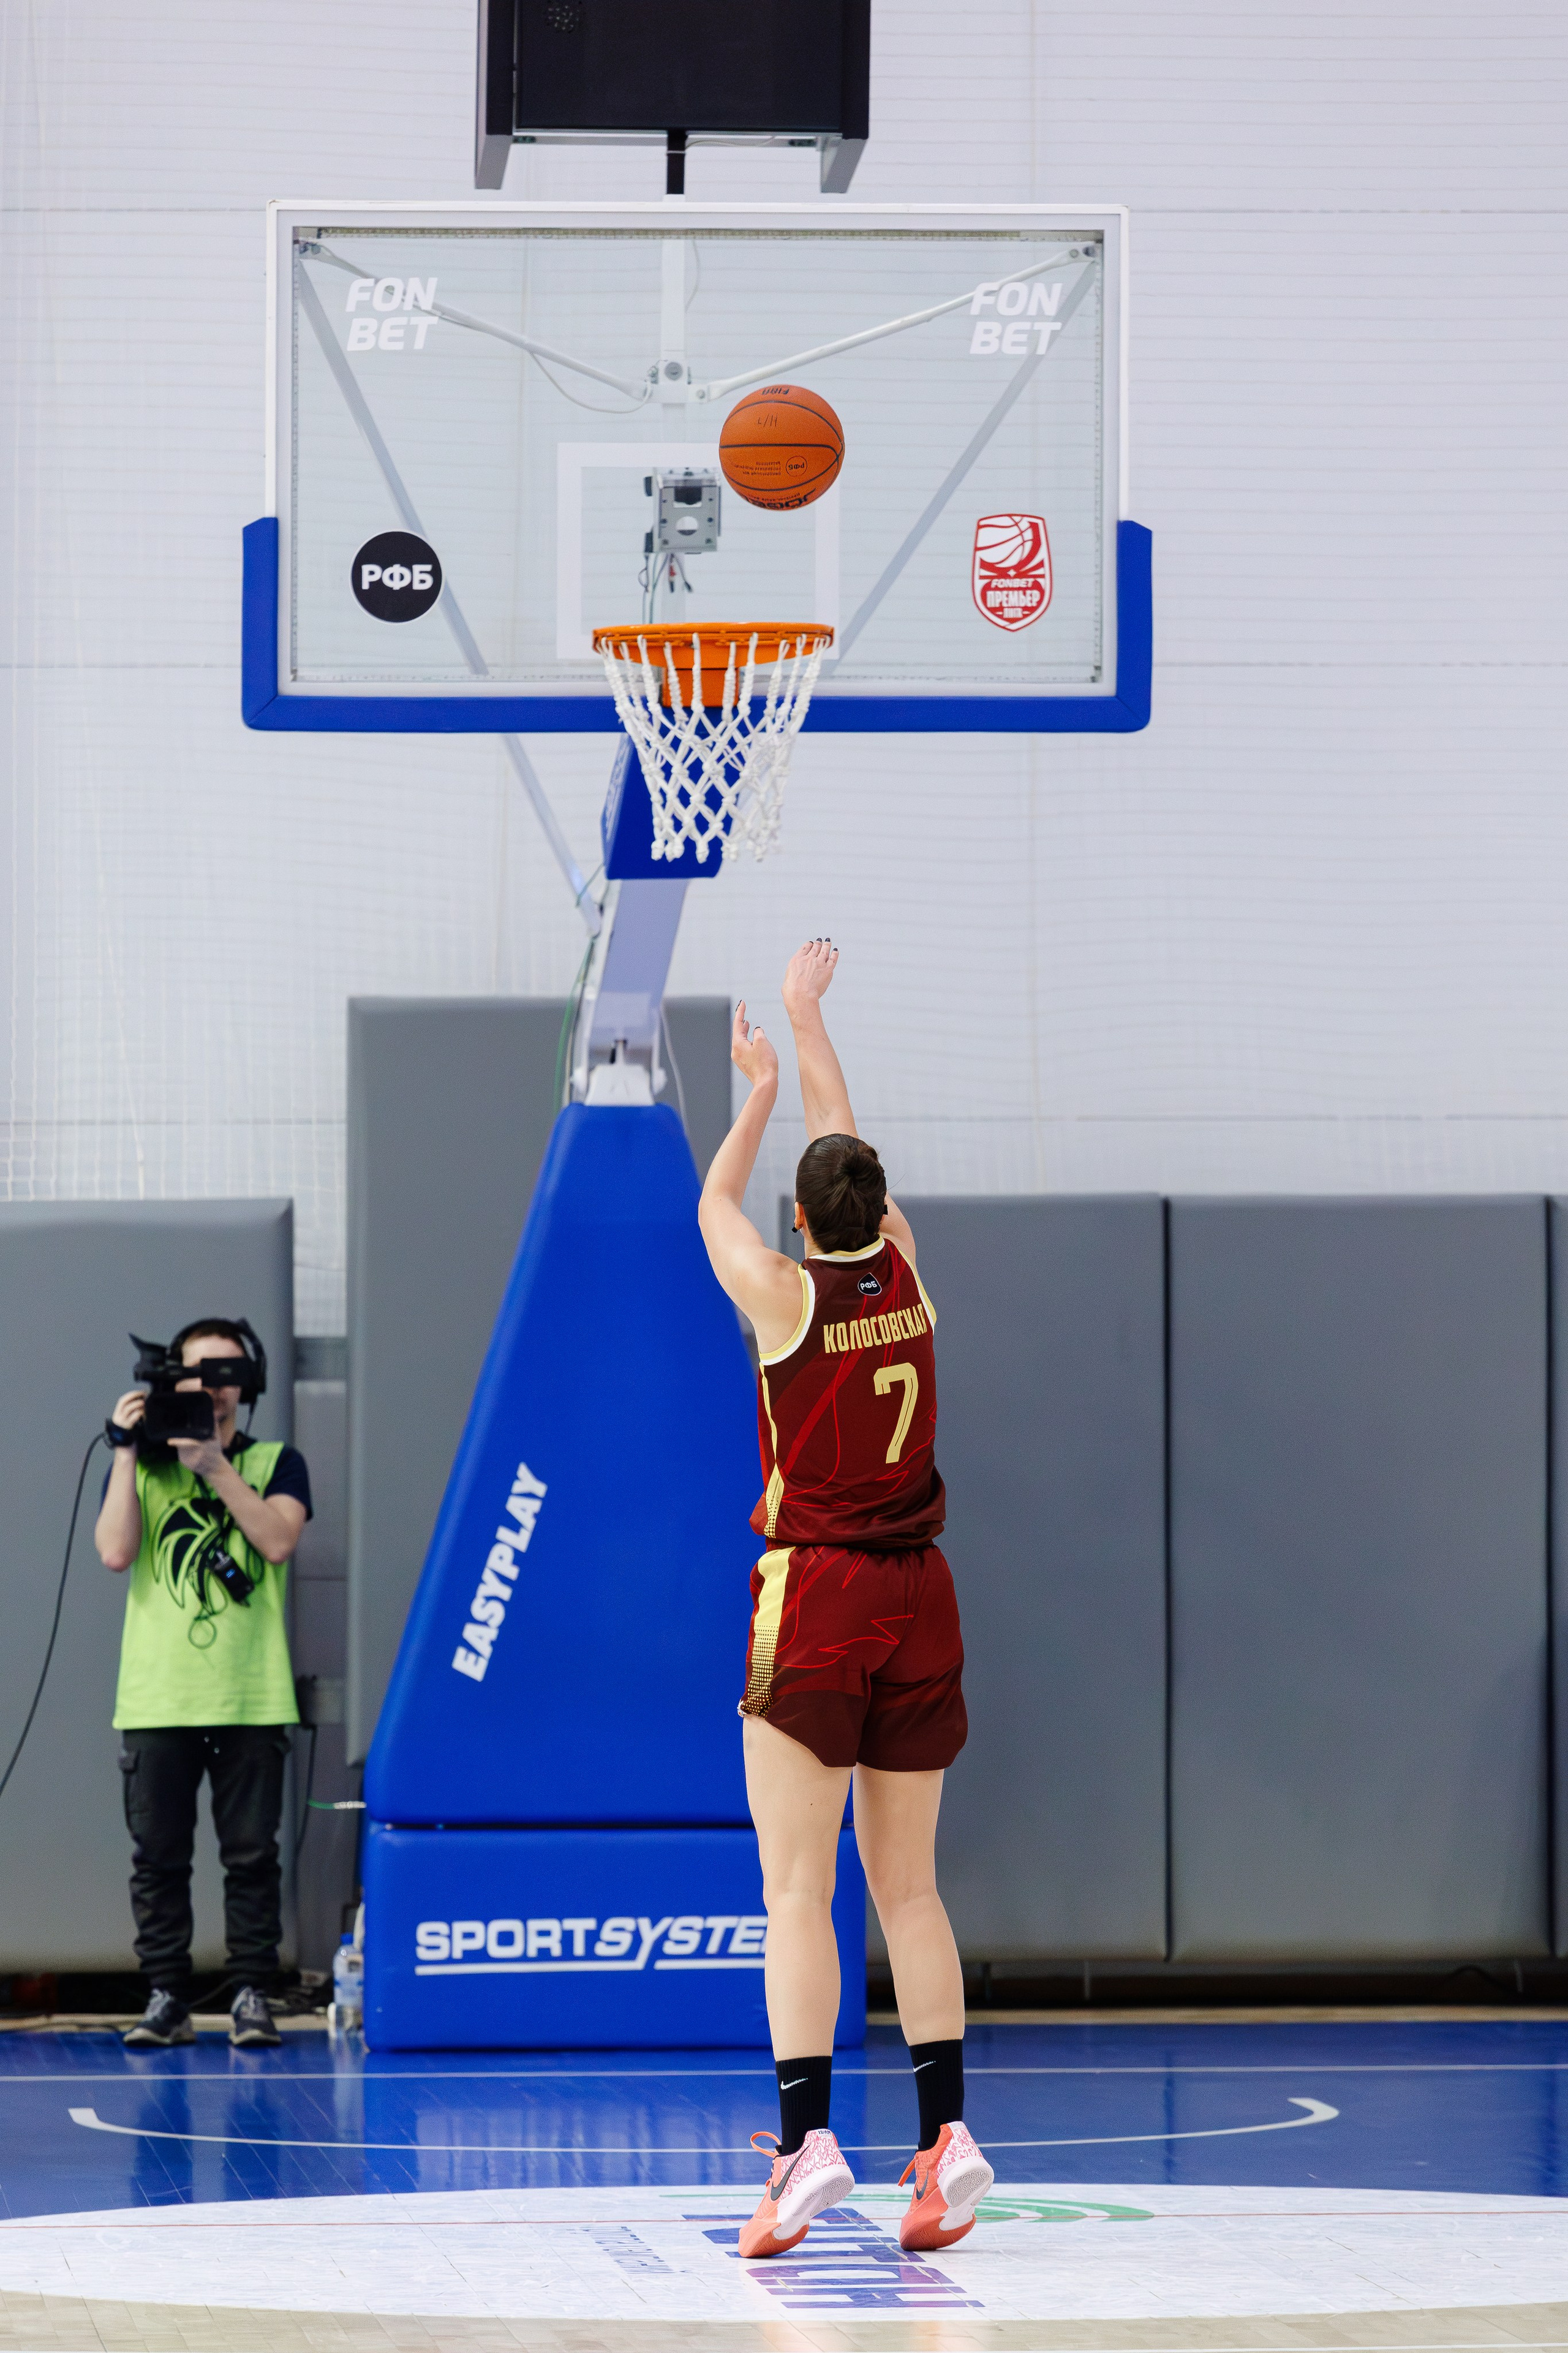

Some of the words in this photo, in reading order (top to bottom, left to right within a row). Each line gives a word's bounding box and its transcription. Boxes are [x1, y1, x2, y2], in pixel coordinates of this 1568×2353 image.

[346, 278, 438, 312] FON
[970, 282, 1063, 316] FON
[347, 316, 439, 351] BET
[970, 322, 1062, 355] BET
[788, 463, 805, 471] РФБ
[361, 563, 434, 591] РФБ
[990, 578, 1035, 588] FONBET
[986, 590, 1041, 608] ПРЕМЬЕР
[860, 1280, 878, 1290] РФБ
[823, 1303, 928, 1353] КОЛОСОВСКАЯ
[873, 1362, 918, 1464] 7
[451, 1462, 549, 1682] EASYPLAY
[415, 1915, 767, 1968] SPORTSYSTE
